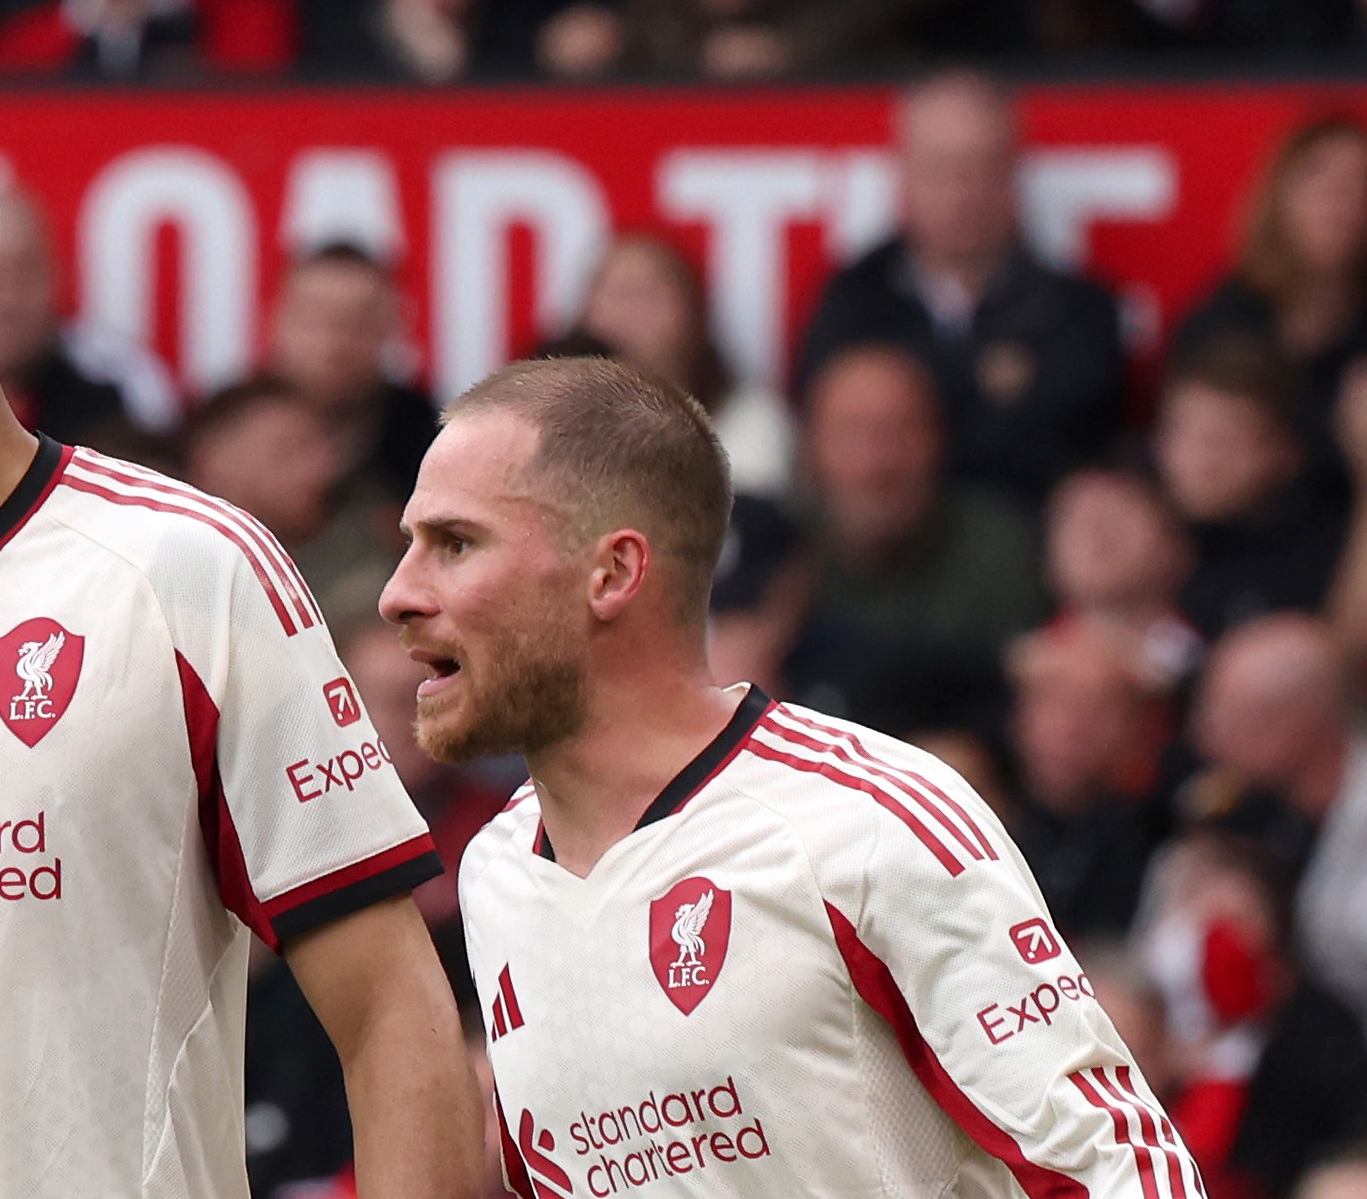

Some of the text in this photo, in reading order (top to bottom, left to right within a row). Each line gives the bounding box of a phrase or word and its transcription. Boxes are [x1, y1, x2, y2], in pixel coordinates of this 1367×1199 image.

[10, 700, 56, 720] L.F.C.
[668, 966, 709, 988] L.F.C.
[569, 1075, 743, 1155] standard
[587, 1117, 771, 1198] chartered
